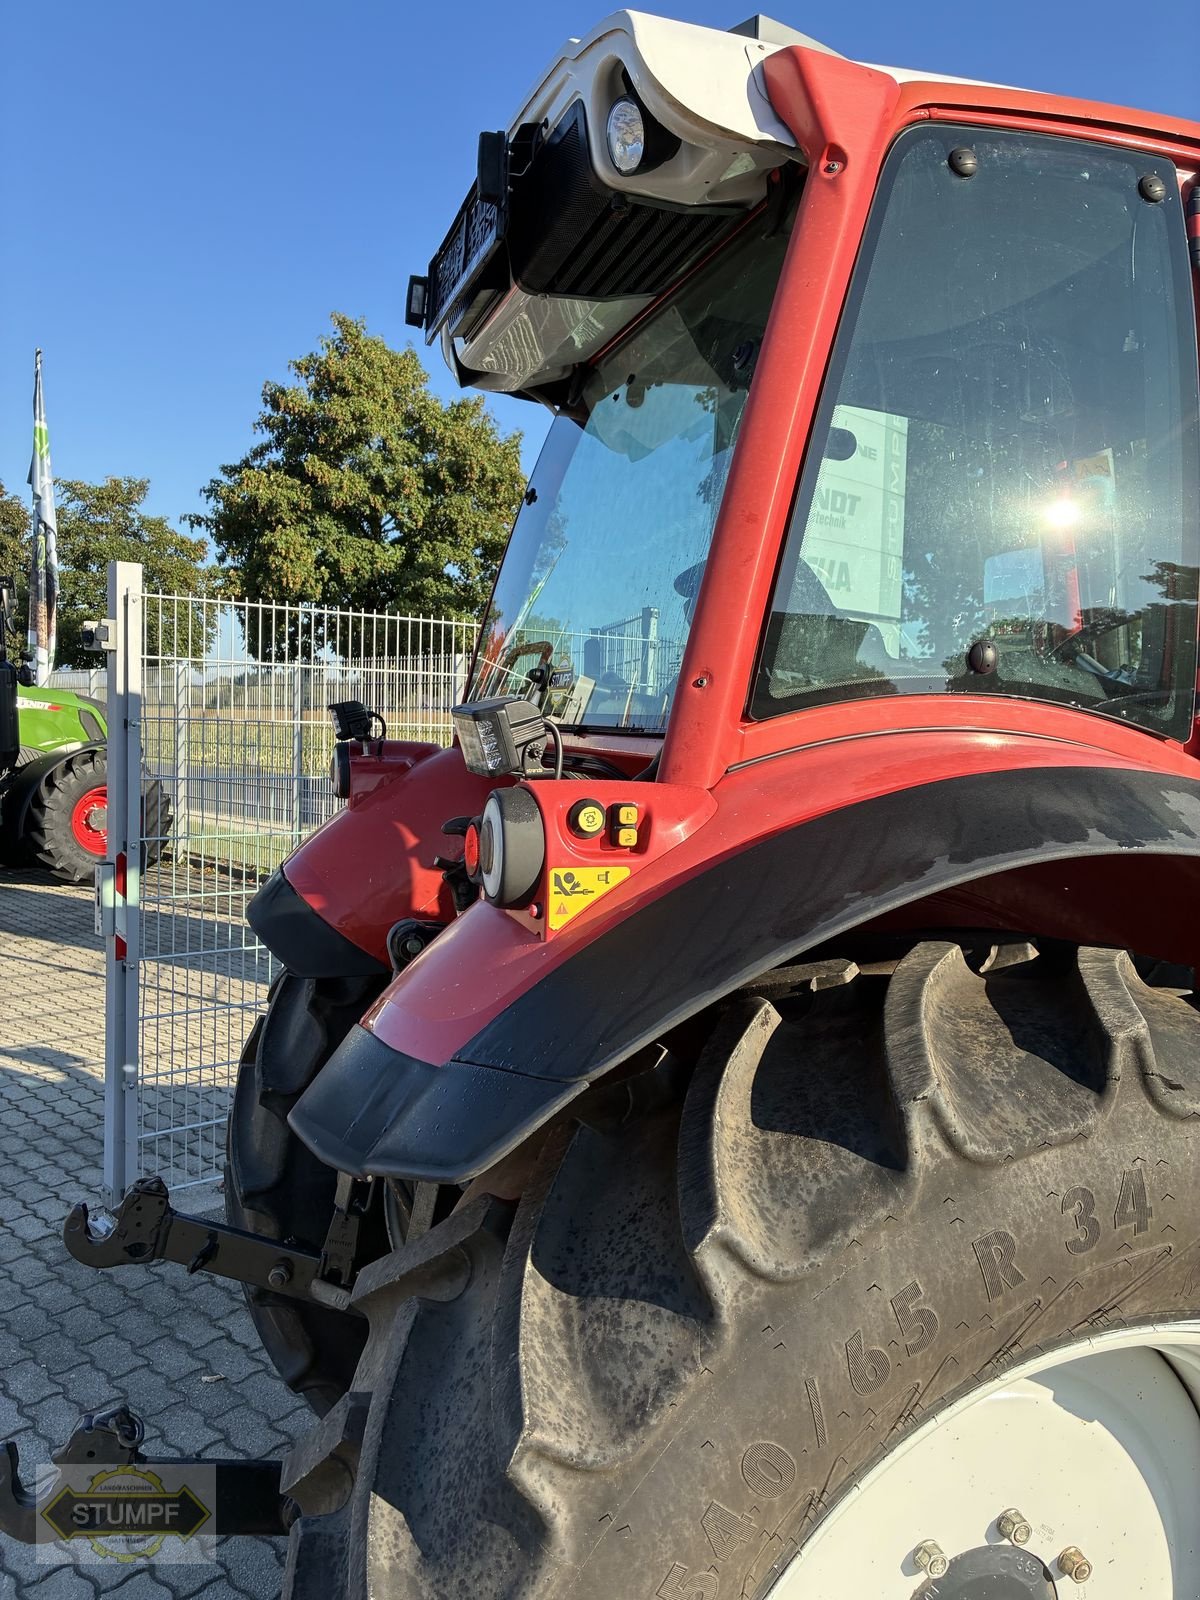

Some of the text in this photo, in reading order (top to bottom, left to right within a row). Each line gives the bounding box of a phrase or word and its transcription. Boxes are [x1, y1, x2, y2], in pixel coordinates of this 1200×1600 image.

[551, 673, 571, 687] STUMPF
[971, 1229, 1027, 1302] R
[1060, 1168, 1154, 1256] 34
